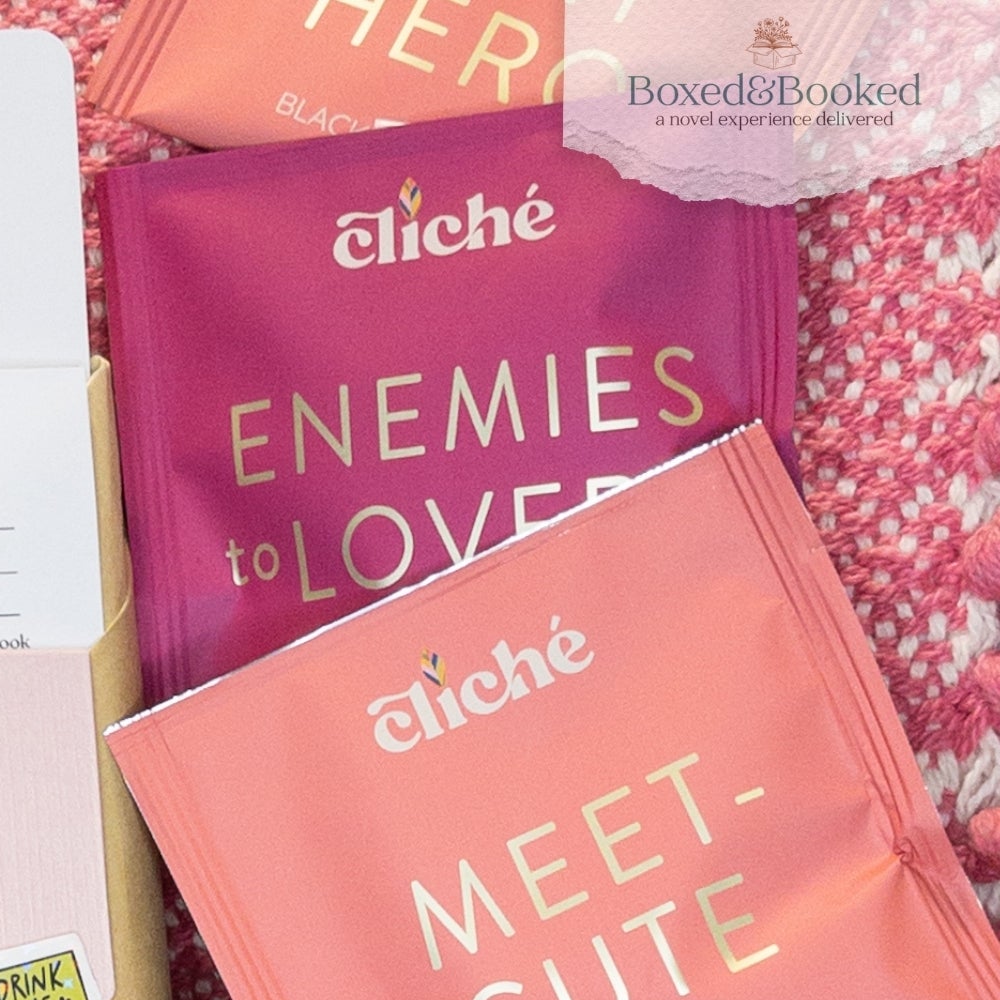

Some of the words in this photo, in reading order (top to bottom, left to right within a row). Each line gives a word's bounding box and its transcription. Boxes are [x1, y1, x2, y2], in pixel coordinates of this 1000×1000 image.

[333, 178, 556, 269] cliché
[230, 346, 704, 487] ENEMIES
[225, 538, 280, 586] to
[292, 475, 632, 602] LOVE
[367, 615, 595, 753] cliché
[410, 752, 765, 971] MEET-
